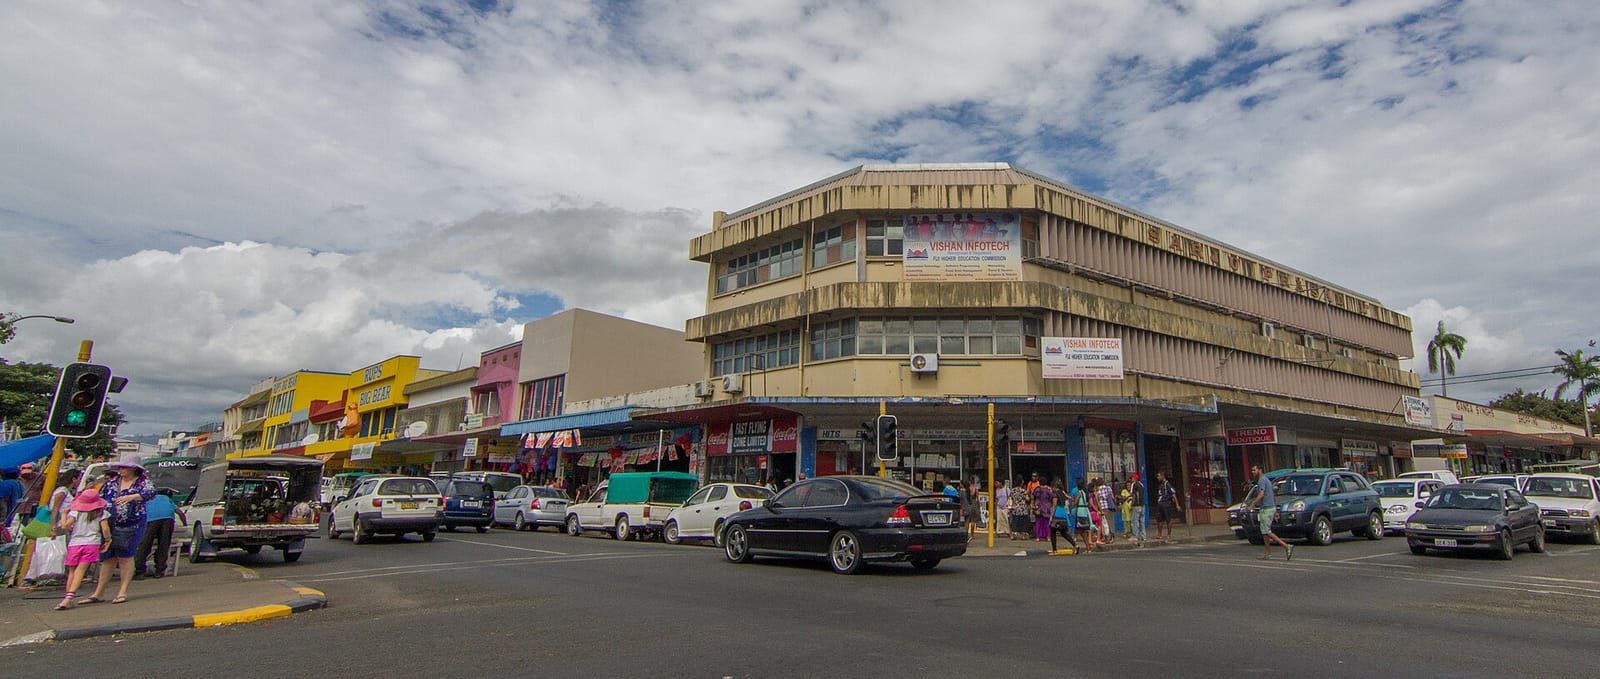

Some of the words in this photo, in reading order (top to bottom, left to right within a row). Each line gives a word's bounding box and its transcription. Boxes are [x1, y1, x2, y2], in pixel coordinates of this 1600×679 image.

[929, 241, 964, 251] VISHAN
[965, 241, 1010, 251] INFOTECH
[1063, 339, 1087, 349] VISHAN
[1089, 339, 1119, 349] INFOTECH
[364, 364, 383, 383] RUPS
[360, 390, 370, 406] BIG
[372, 385, 391, 402] BEAR
[735, 422, 748, 435] FAST
[748, 420, 767, 434] FLYING
[1234, 428, 1267, 437] TREND
[822, 430, 841, 438] HITS
[1230, 435, 1272, 443] BOUTIQUE
[733, 437, 747, 447] ZONE
[747, 435, 767, 447] LIMITED
